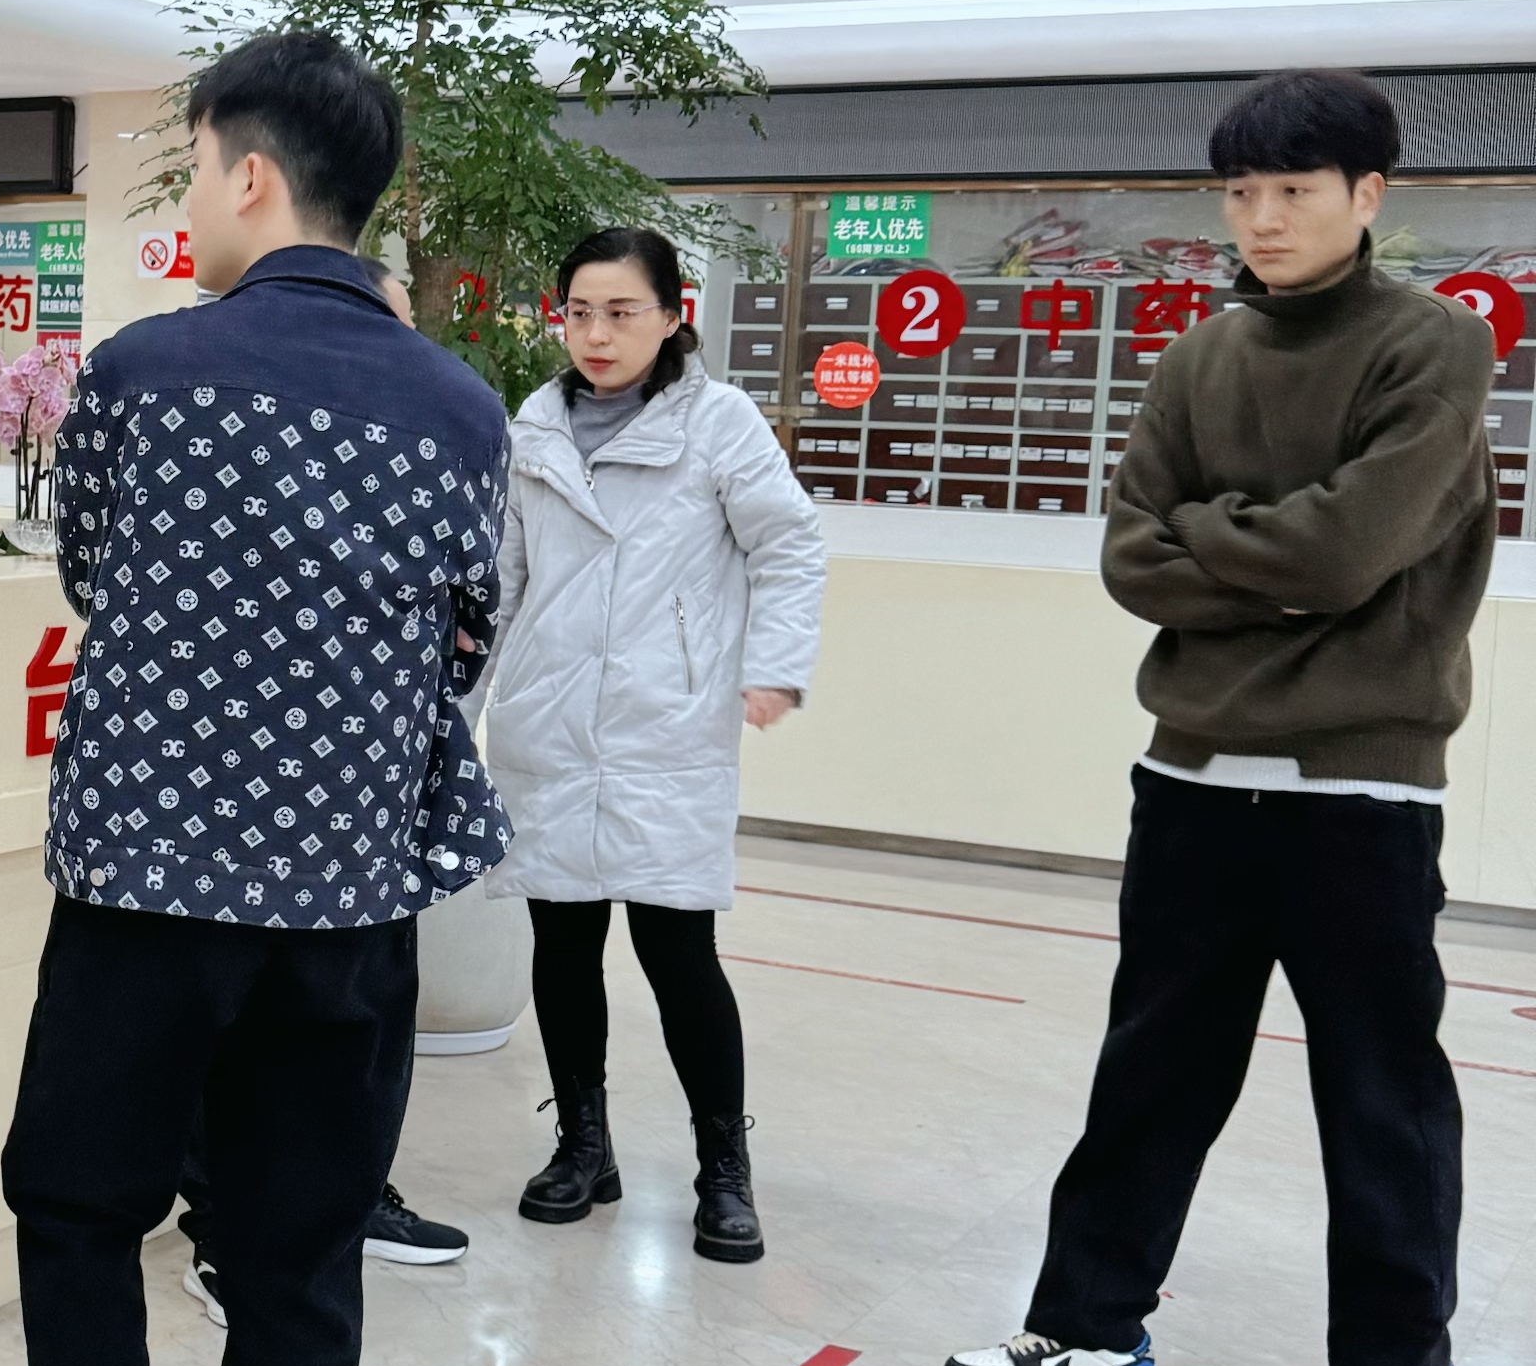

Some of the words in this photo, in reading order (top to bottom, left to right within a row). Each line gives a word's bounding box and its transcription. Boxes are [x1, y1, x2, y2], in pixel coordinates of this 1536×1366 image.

[845, 195, 917, 212] 温馨提示
[833, 218, 924, 241] 老年人优先
[900, 285, 940, 342] 2
[821, 354, 874, 368] 一米线外
